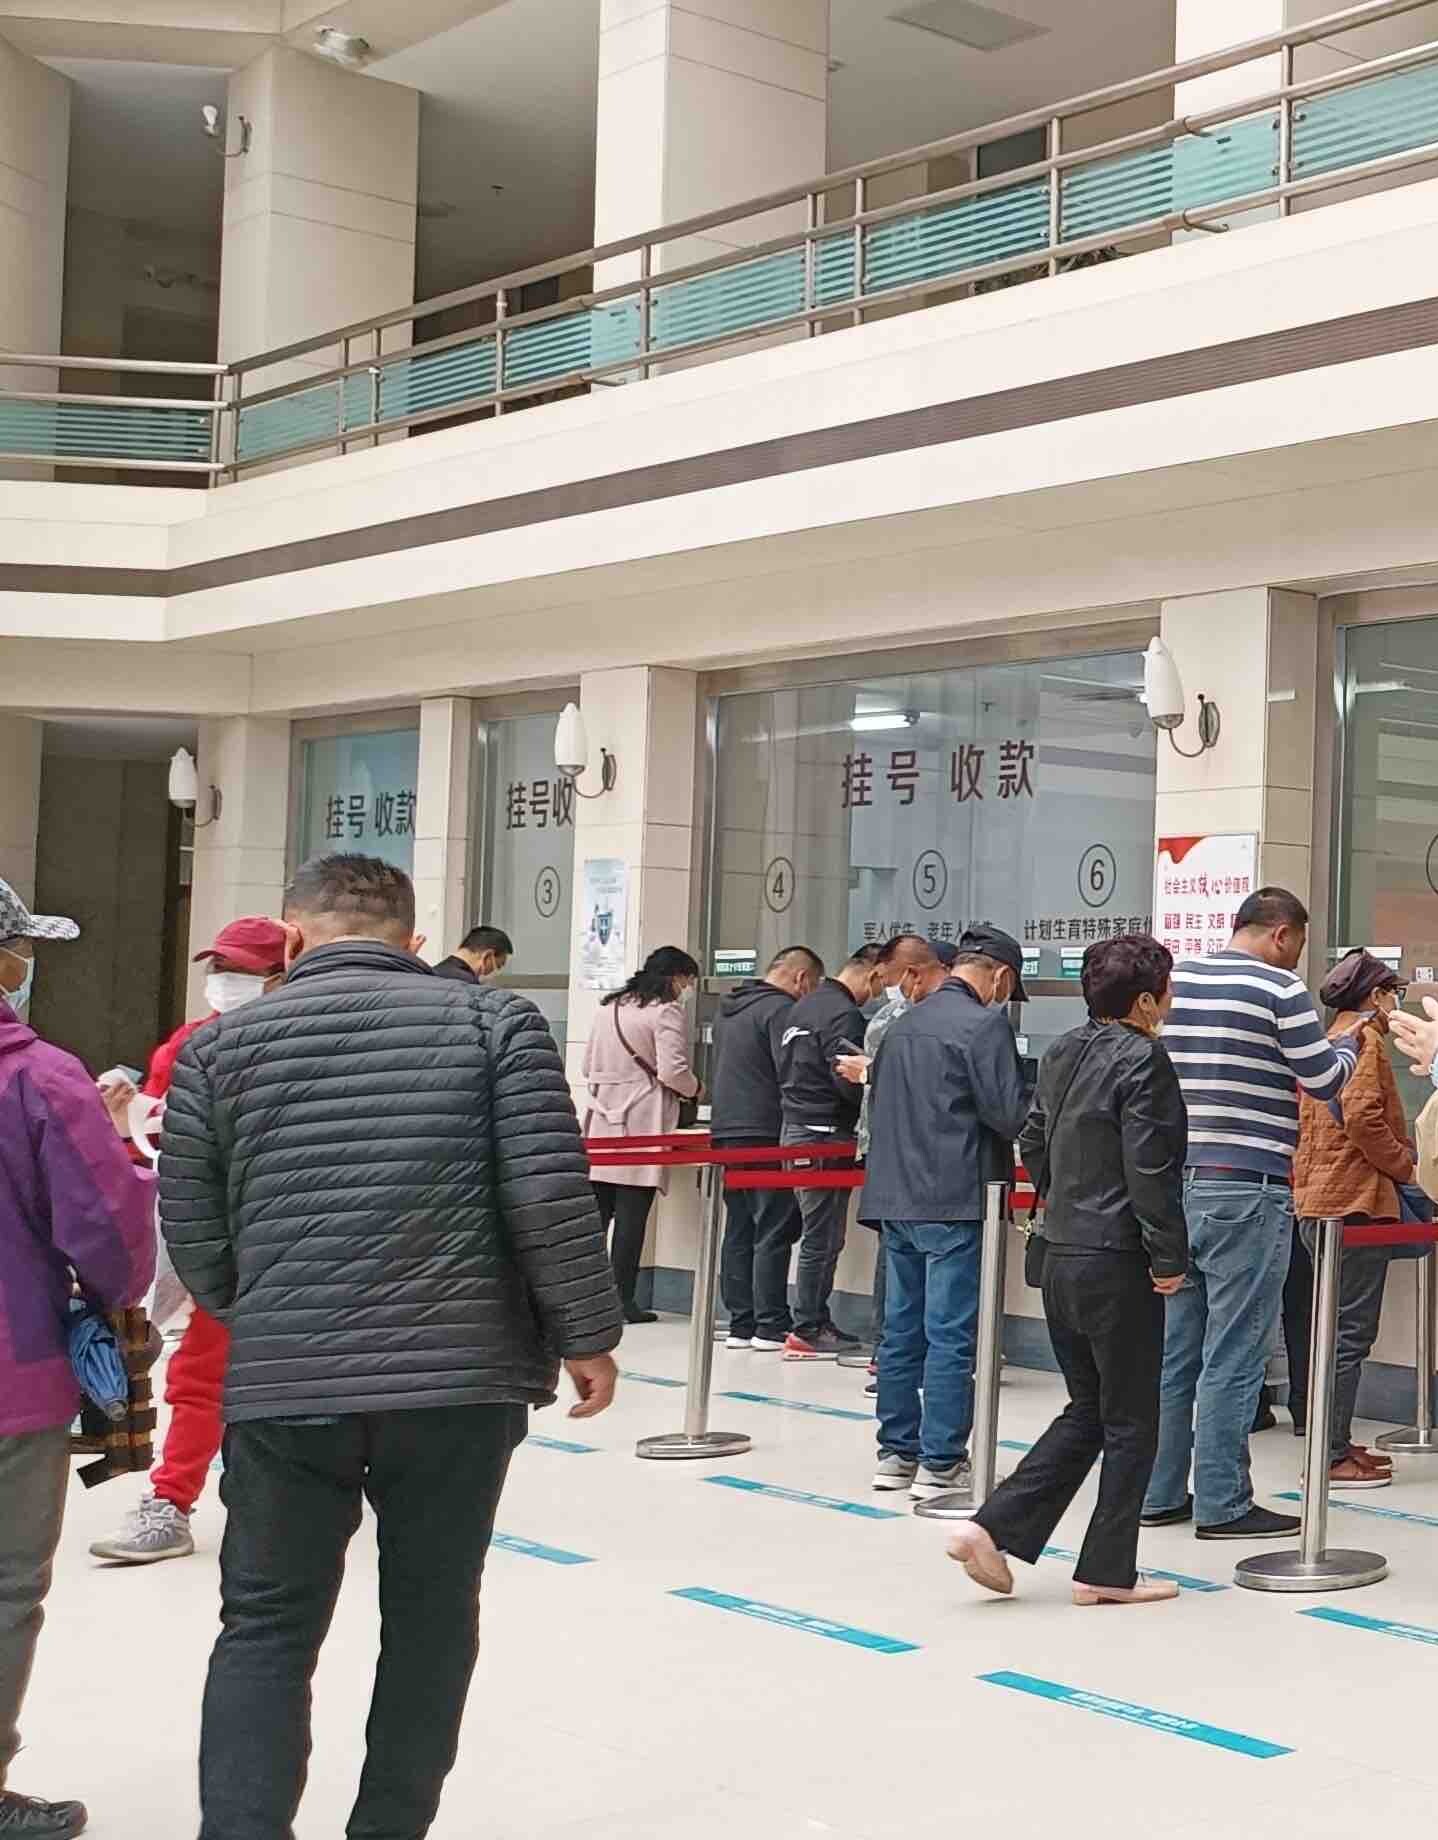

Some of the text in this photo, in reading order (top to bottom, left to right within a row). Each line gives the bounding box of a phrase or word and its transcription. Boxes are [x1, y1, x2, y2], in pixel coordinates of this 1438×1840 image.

[841, 739, 1036, 809] 挂号 收款
[326, 790, 416, 840] 挂号 收款
